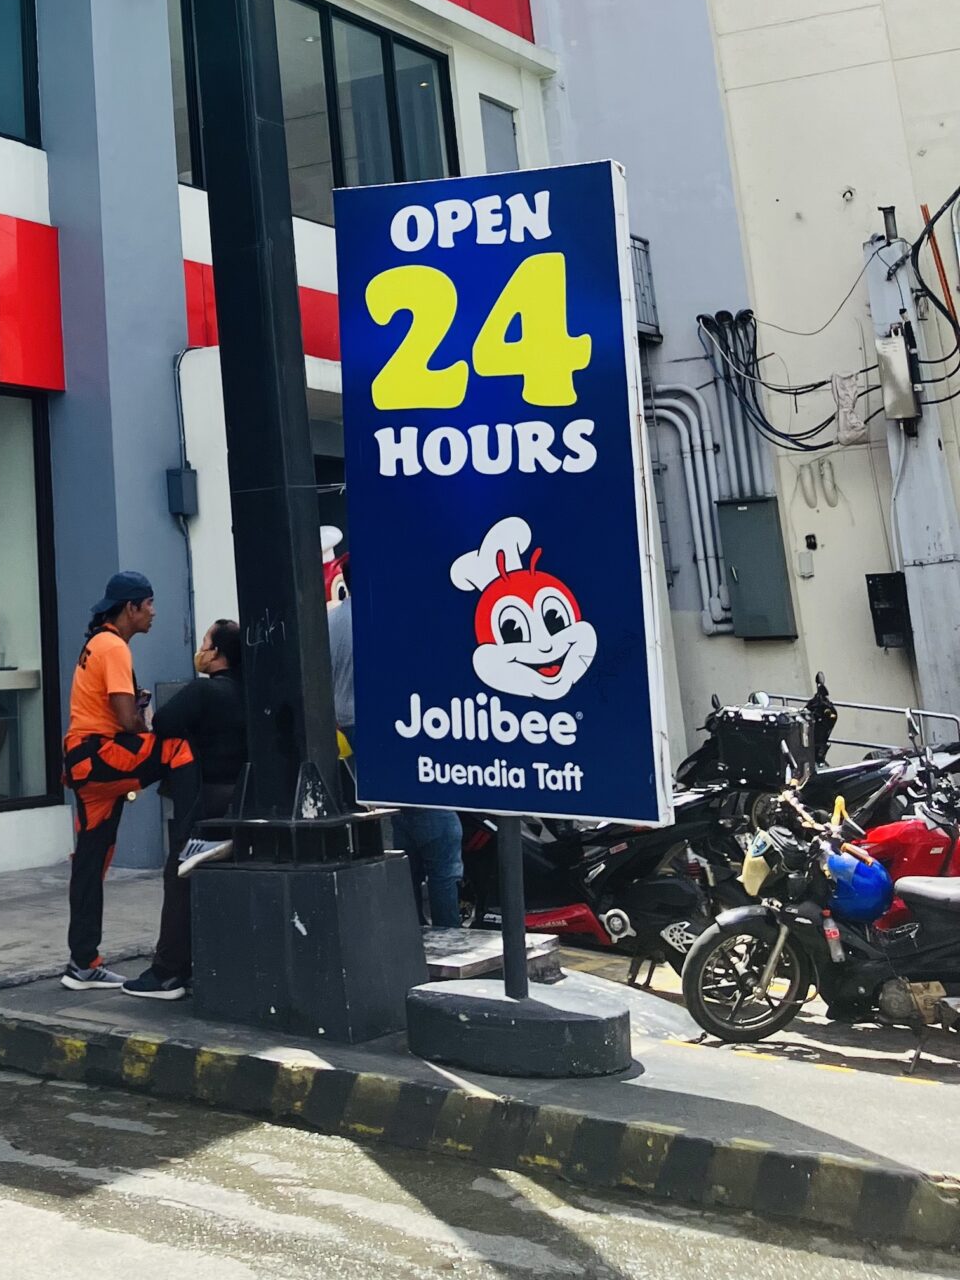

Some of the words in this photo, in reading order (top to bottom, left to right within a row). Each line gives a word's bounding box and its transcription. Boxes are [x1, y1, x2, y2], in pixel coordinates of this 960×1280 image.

[390, 190, 552, 252] OPEN
[365, 252, 592, 410] 24
[374, 419, 598, 477] HOURS
[418, 755, 526, 789] Buendia
[532, 762, 585, 792] Taft
